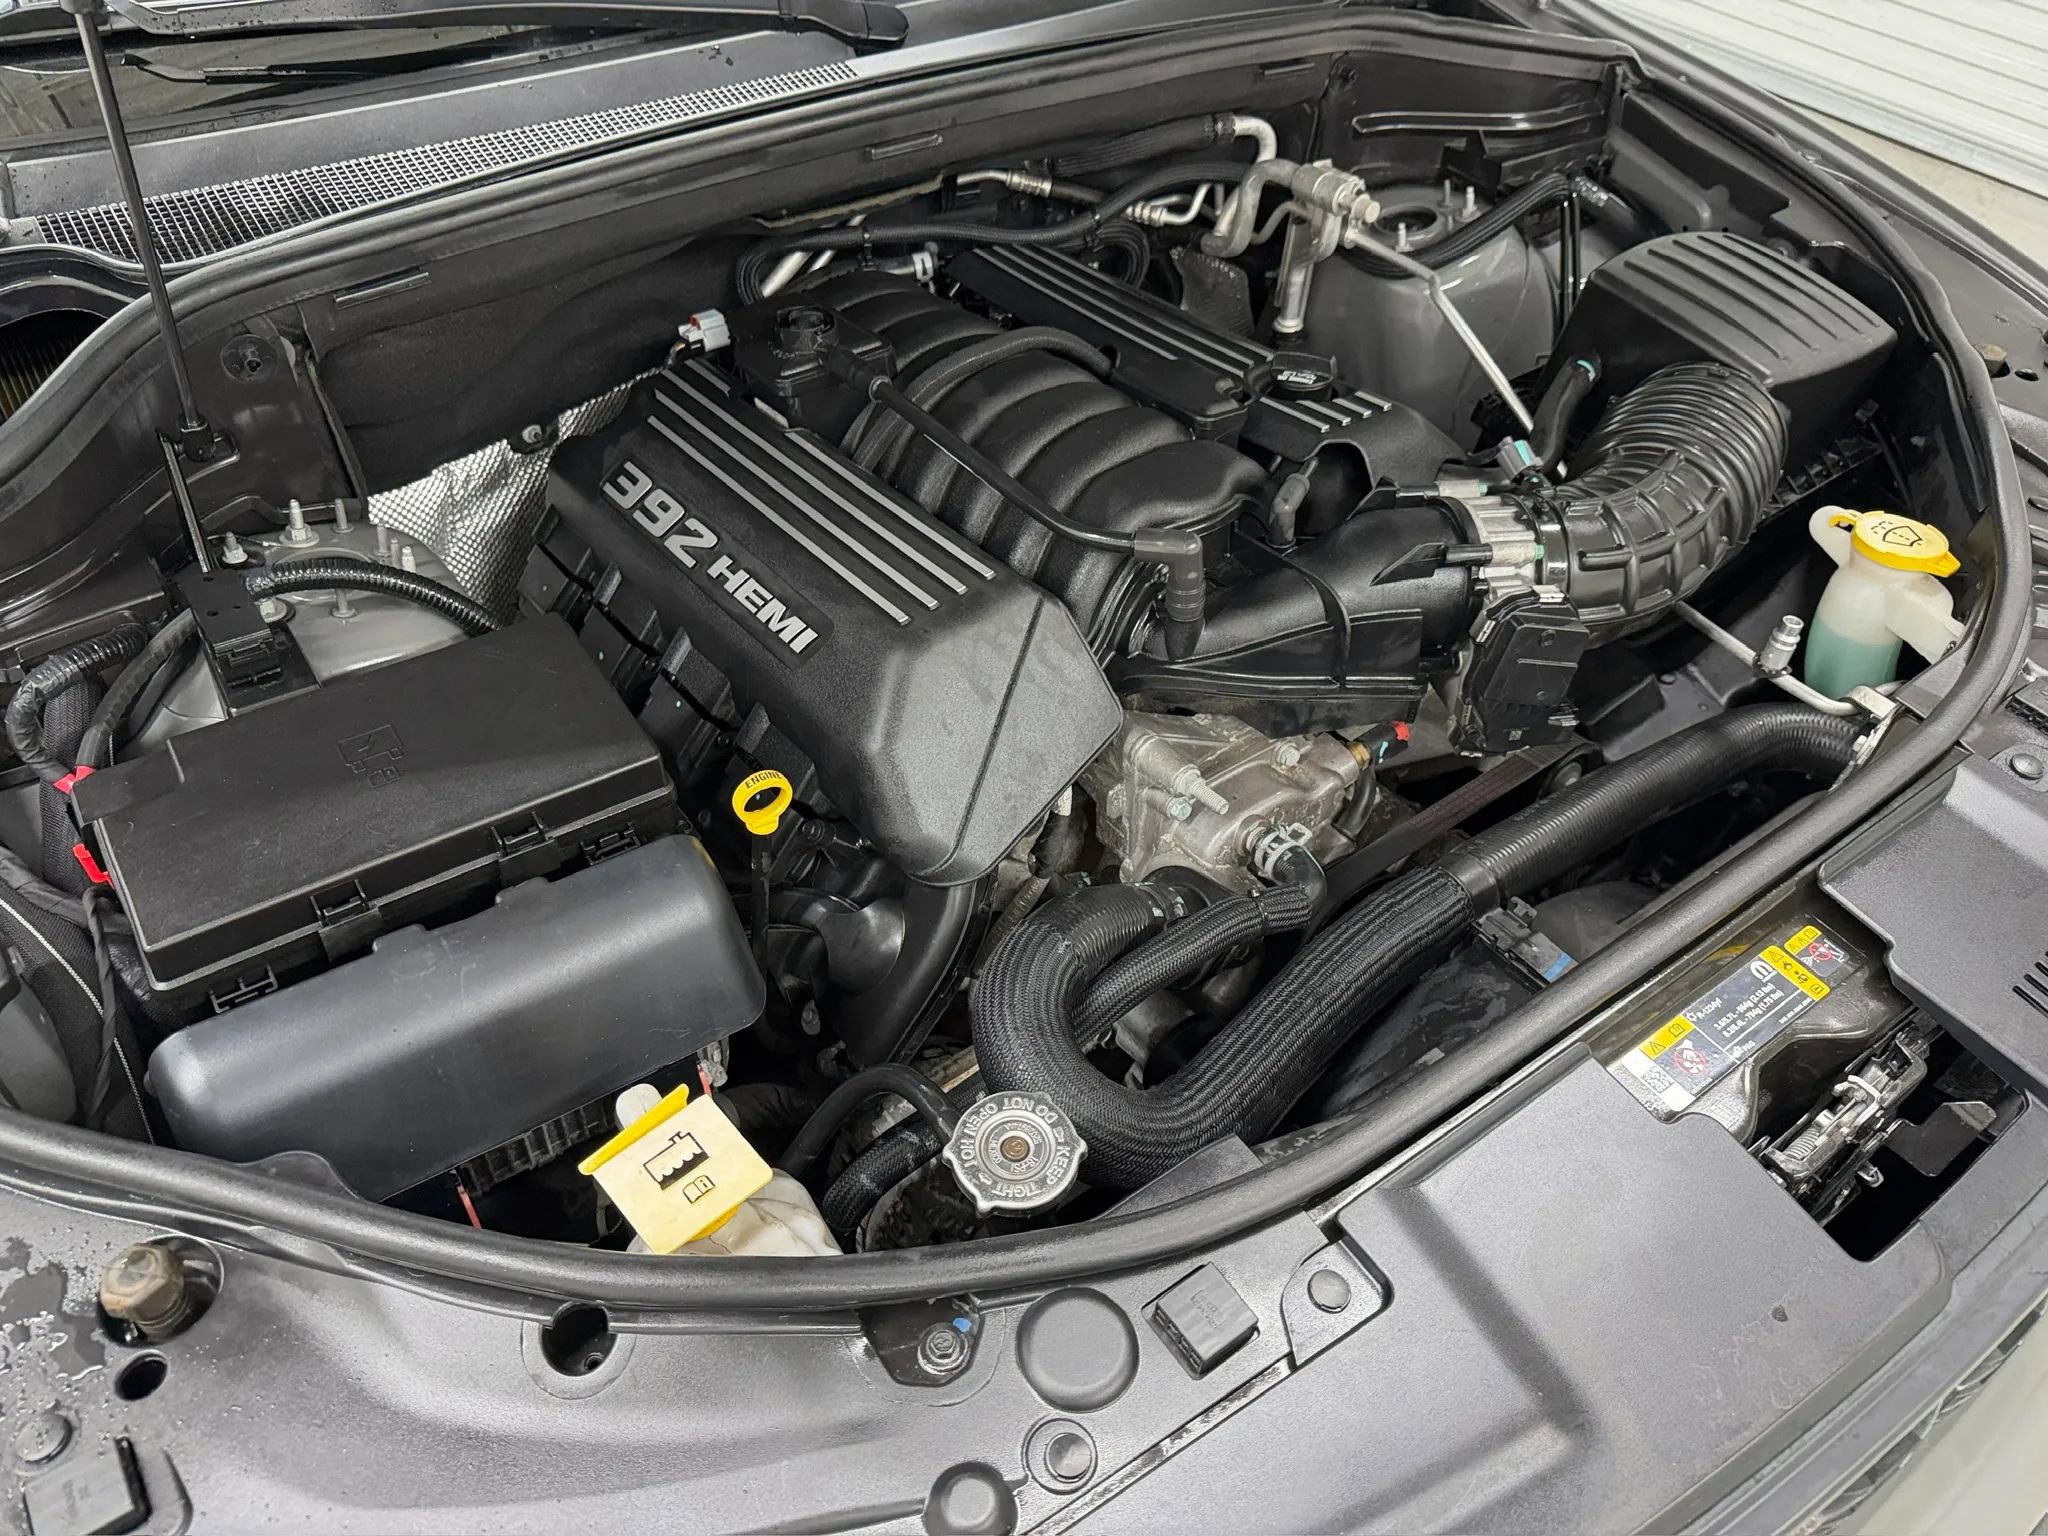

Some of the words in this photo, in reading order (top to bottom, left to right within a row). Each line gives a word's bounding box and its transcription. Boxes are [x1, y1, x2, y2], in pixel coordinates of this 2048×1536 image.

[602, 461, 718, 568] 392
[707, 555, 818, 653] HEMI
[745, 771, 783, 789] ENGINE
[1002, 1097, 1035, 1111] NOT
[1035, 1104, 1059, 1124] DO
[963, 1102, 999, 1136] OPEN
[960, 1139, 978, 1168] HOT
[1046, 1145, 1071, 1185] KEEP
[991, 1182, 1042, 1198] TIGHT
